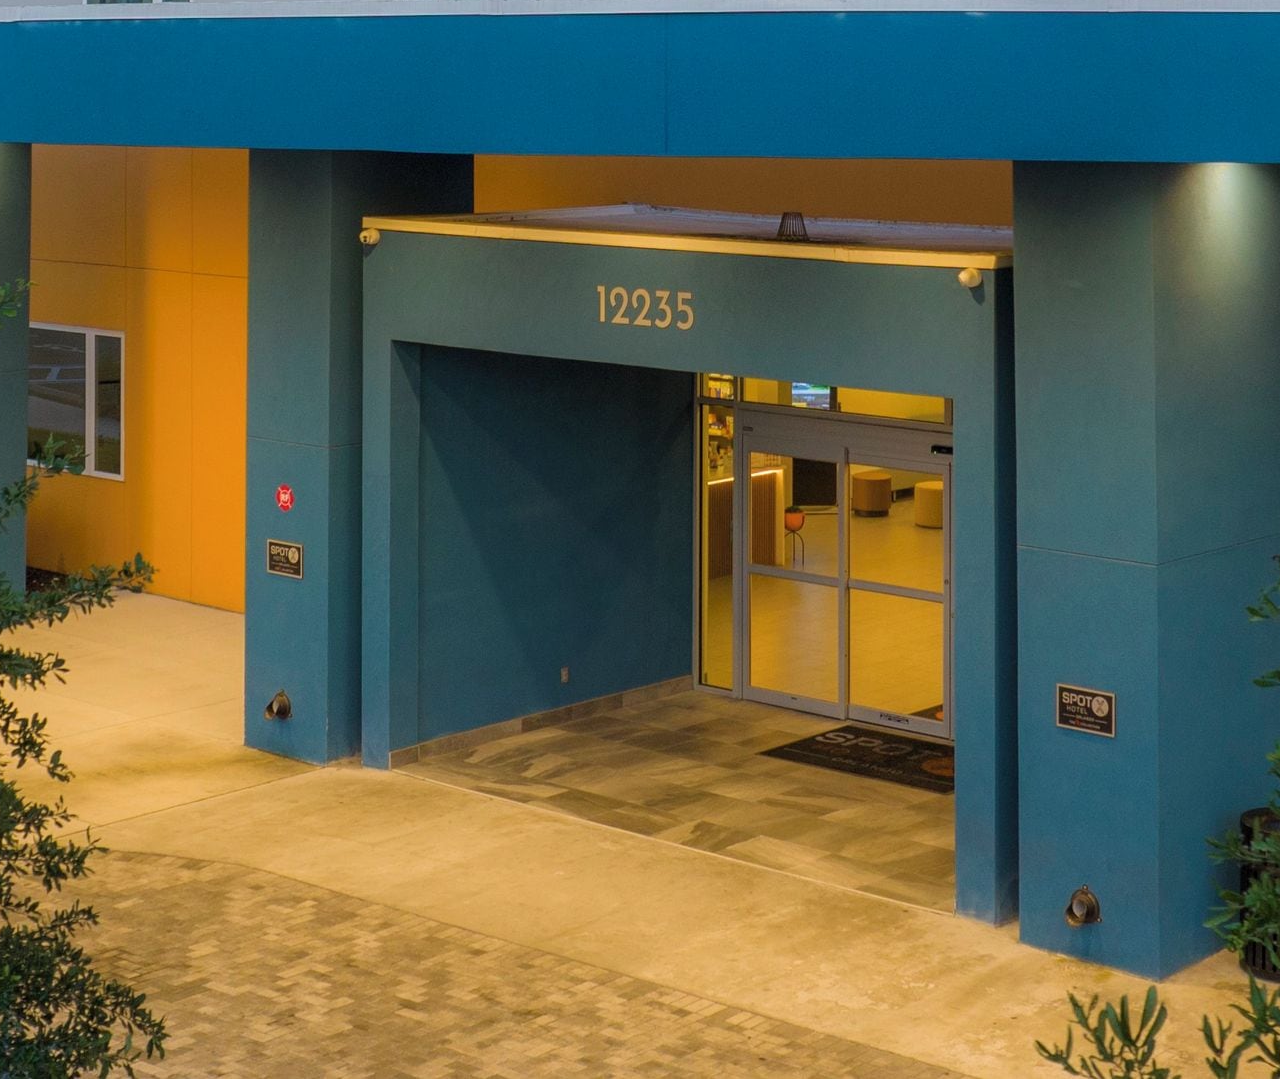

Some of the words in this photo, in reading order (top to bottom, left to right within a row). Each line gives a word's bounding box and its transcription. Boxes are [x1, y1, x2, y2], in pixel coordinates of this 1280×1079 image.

[596, 285, 695, 331] 12235
[270, 545, 289, 557] SPOT
[1062, 691, 1093, 708] SPOT
[1066, 705, 1088, 715] HOTEL
